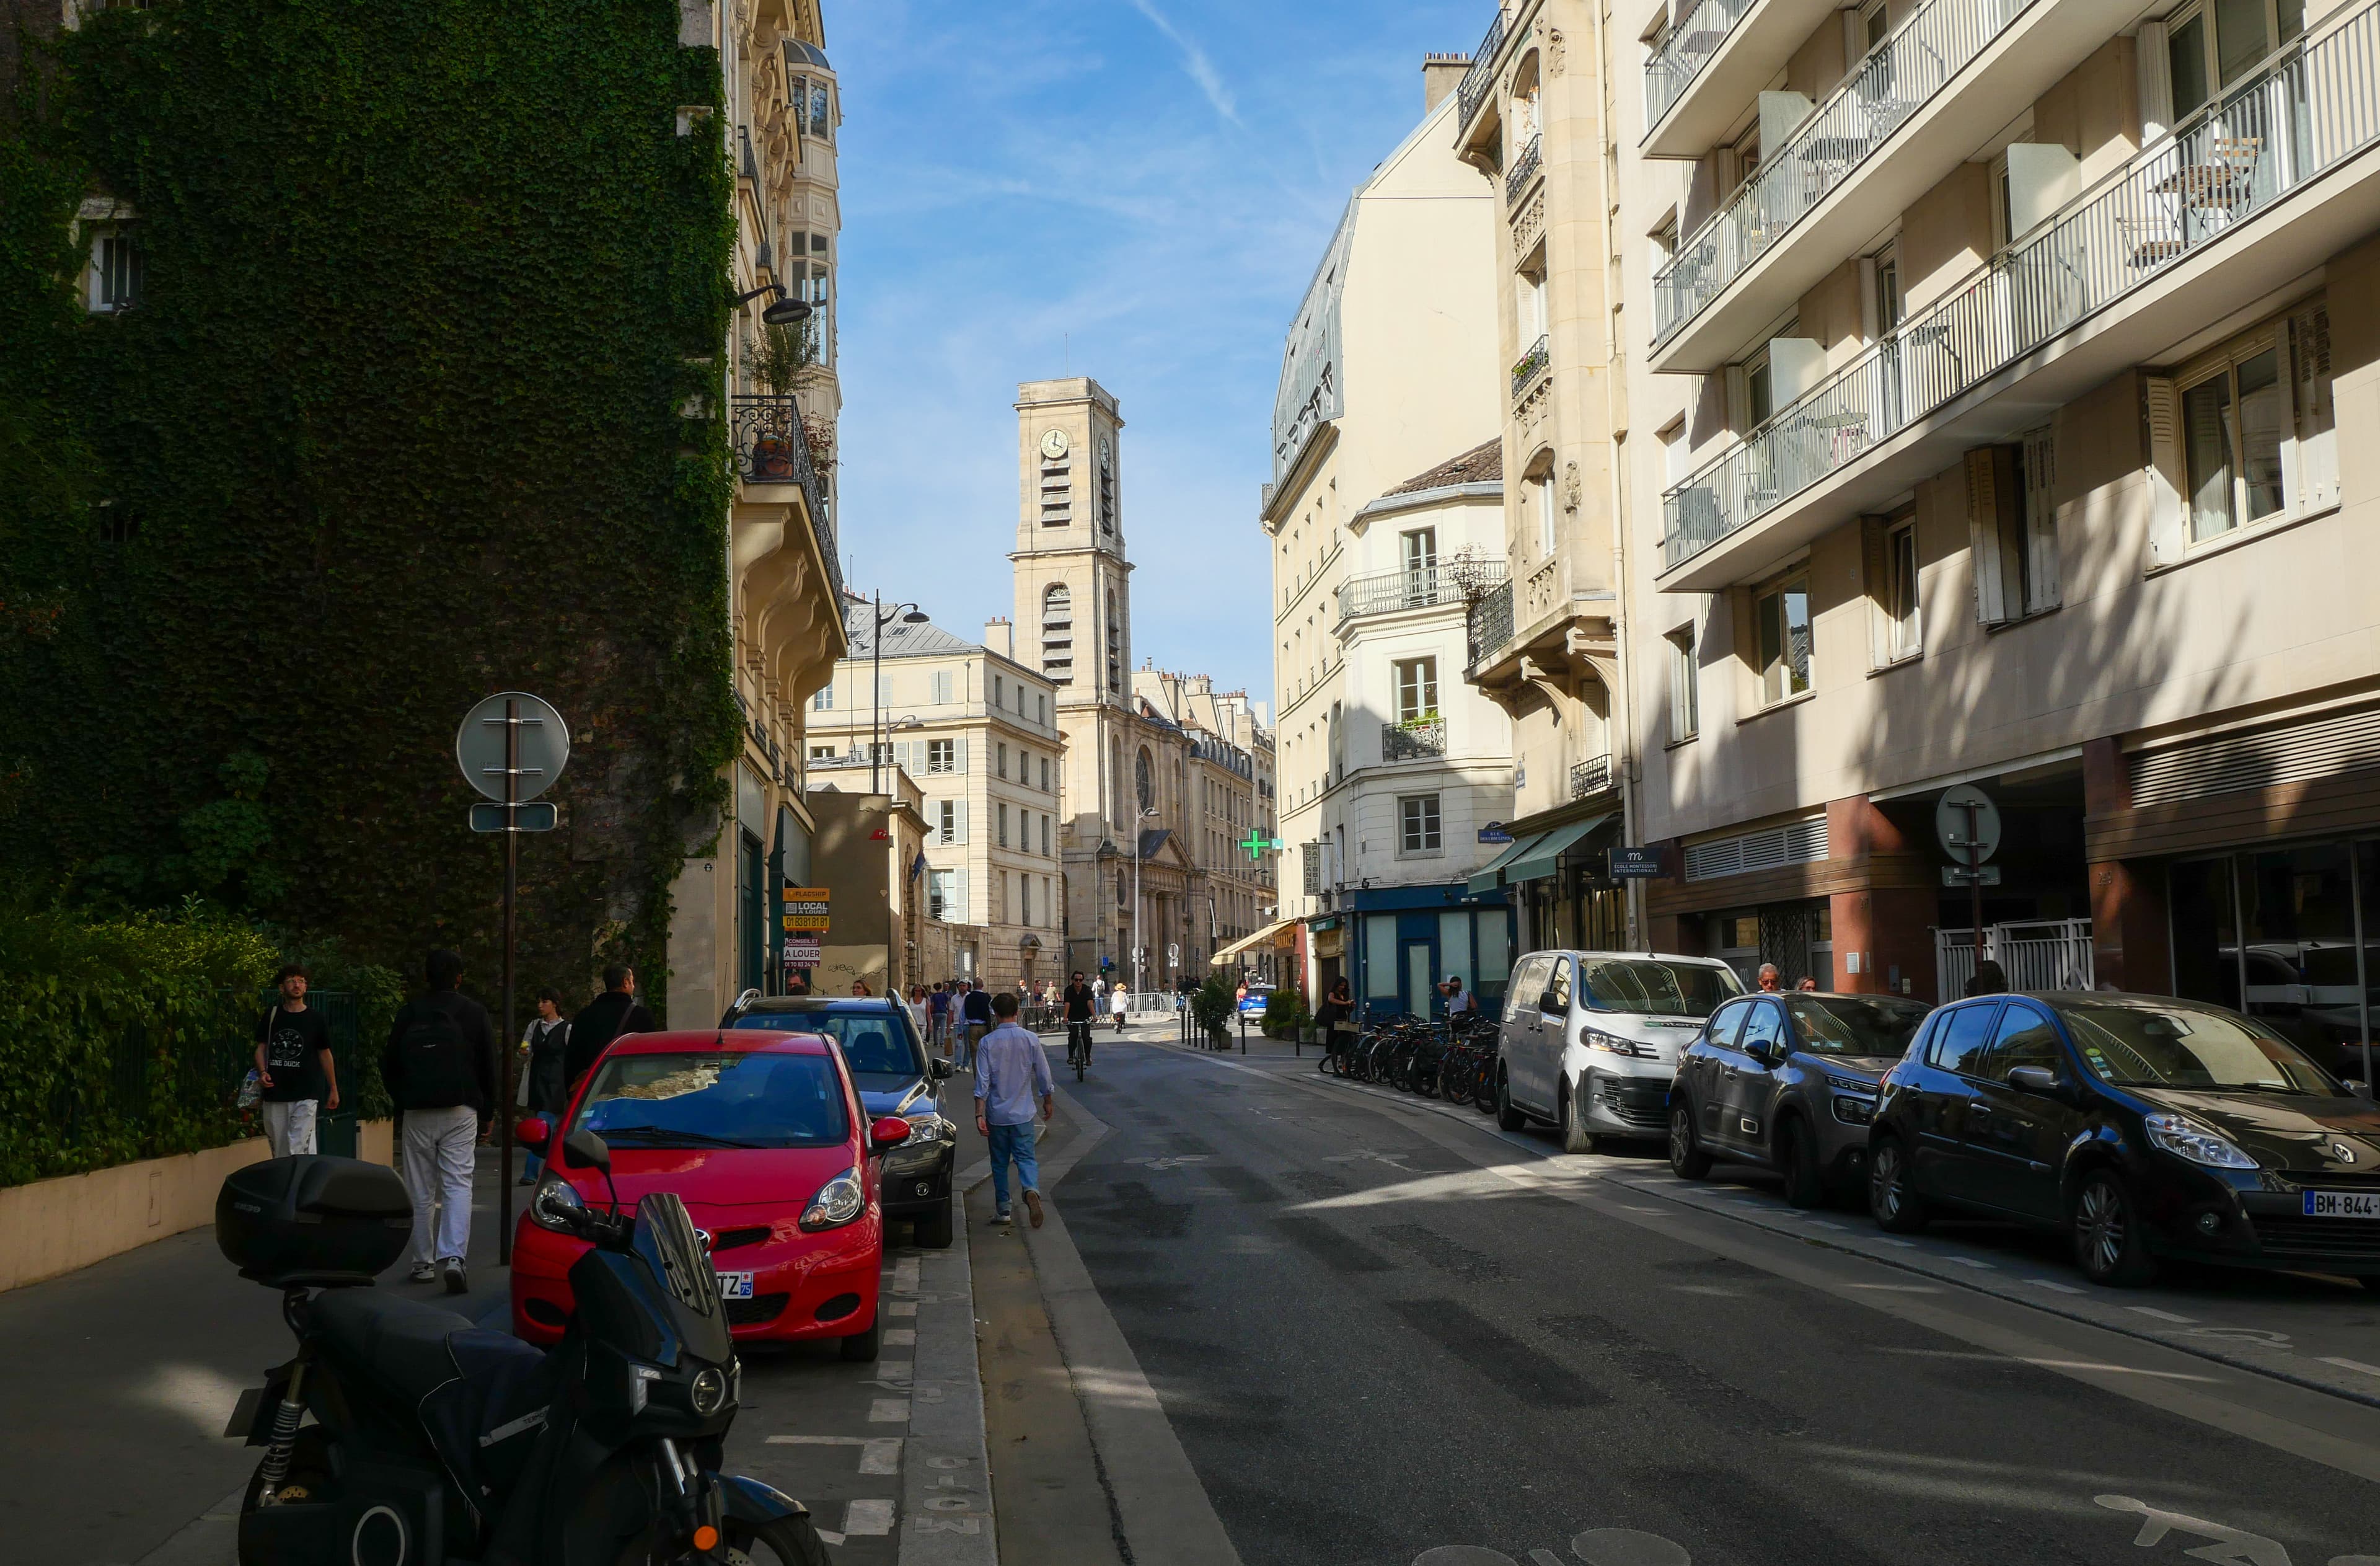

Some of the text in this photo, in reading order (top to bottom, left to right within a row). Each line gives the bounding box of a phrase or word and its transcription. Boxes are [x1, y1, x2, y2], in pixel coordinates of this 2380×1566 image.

[1627, 852, 1642, 860] m
[798, 902, 828, 910] LOCAL
[787, 917, 827, 927] 01 83 81 81 81
[785, 950, 820, 958] A LOUER
[2316, 1195, 2380, 1214] BM-844-
[741, 1285, 751, 1294] 75
